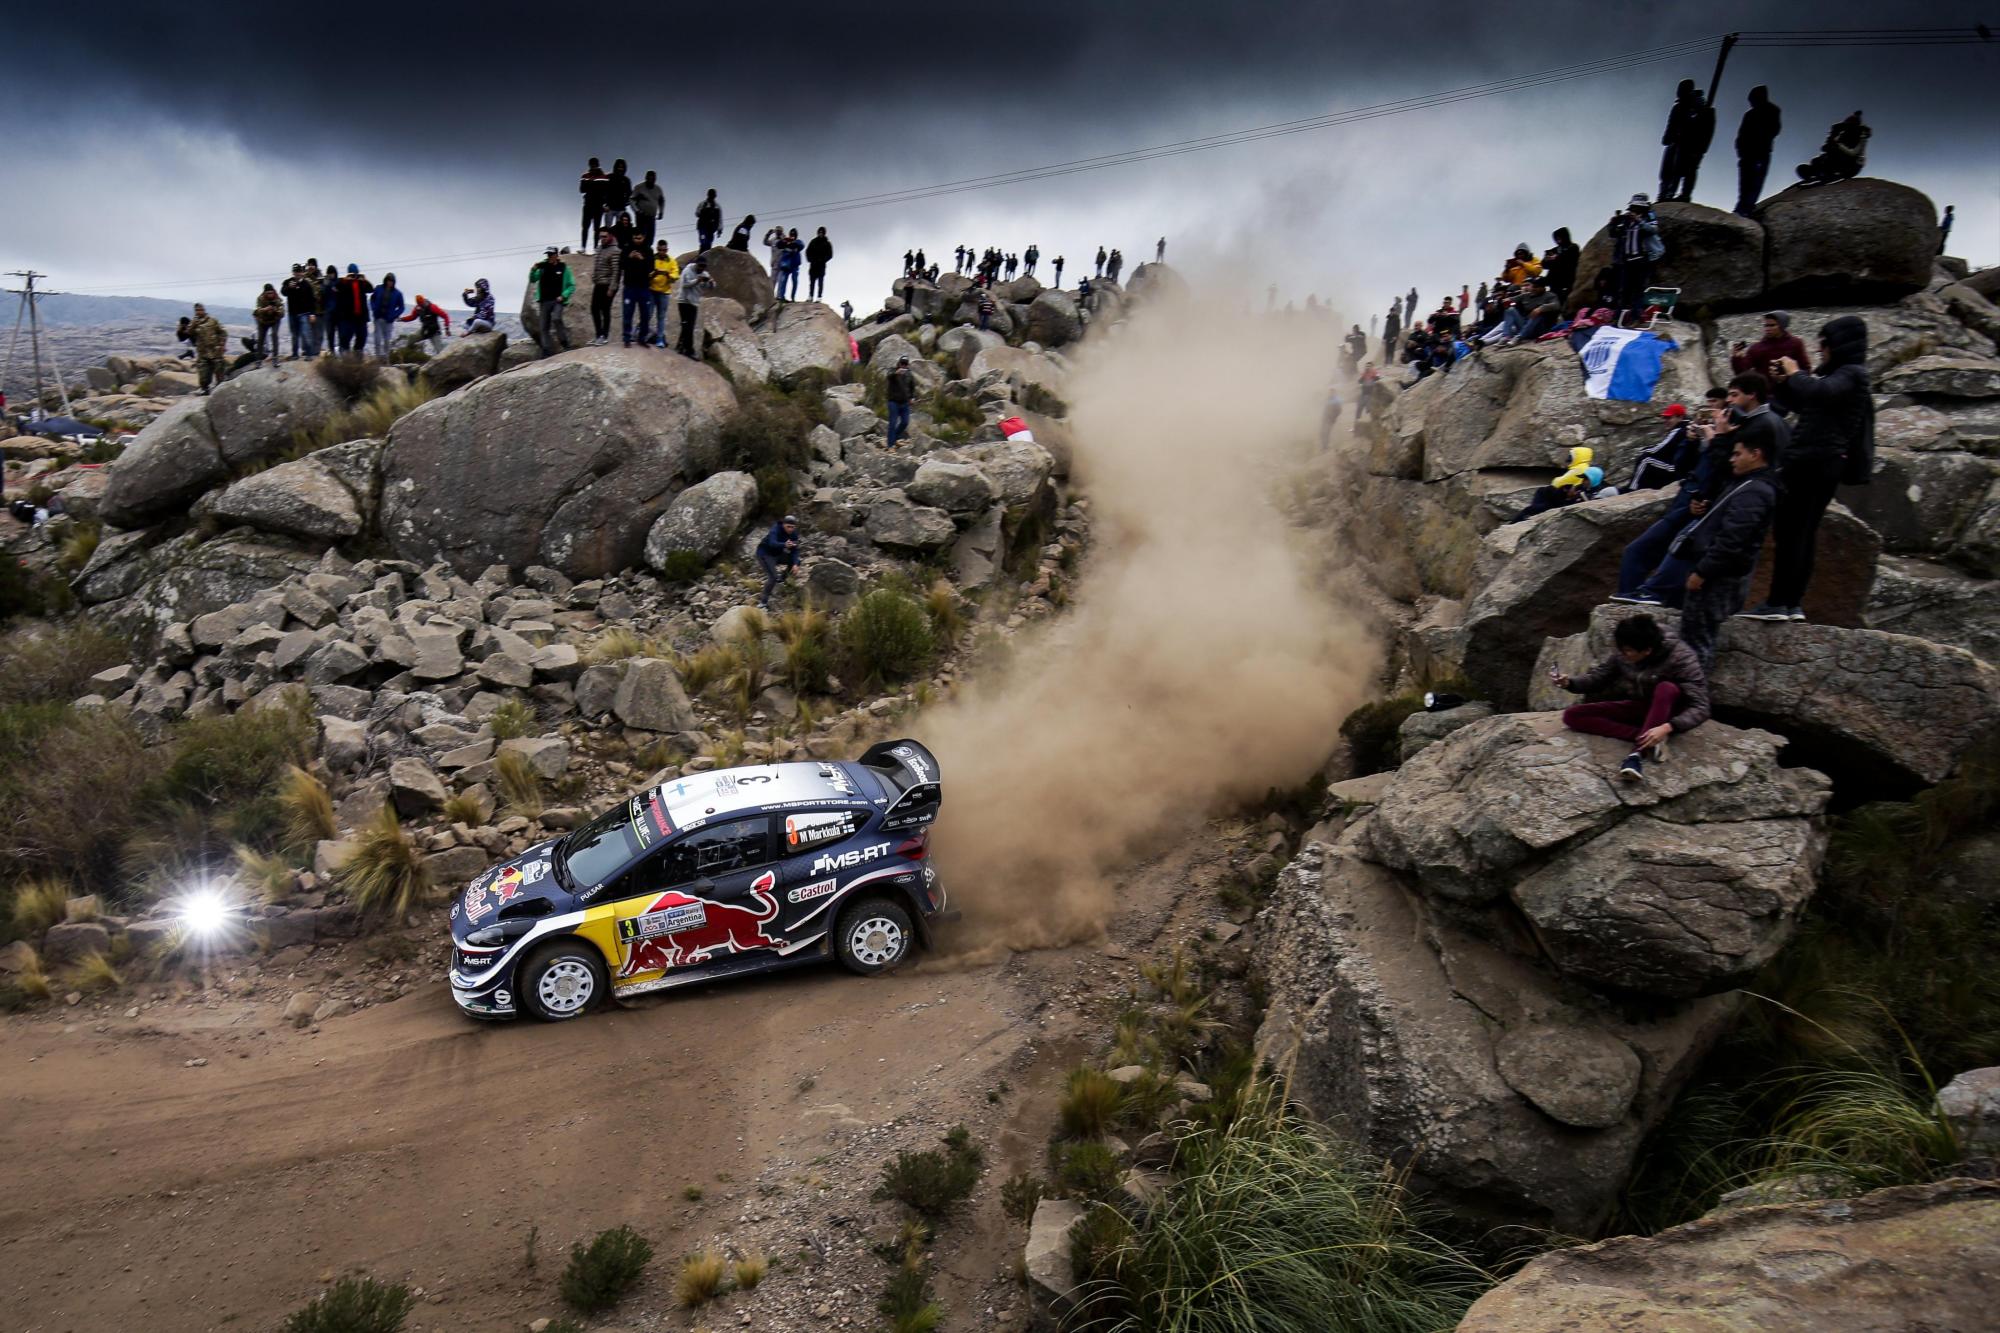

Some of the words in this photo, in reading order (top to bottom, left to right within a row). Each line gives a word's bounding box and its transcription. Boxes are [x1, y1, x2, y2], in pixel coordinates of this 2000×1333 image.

[737, 775, 771, 785] 3
[761, 799, 868, 810] www.MSPORTSTORE.com
[786, 819, 798, 845] 3
[800, 831, 808, 843] M
[808, 824, 841, 841] Markkula
[826, 841, 891, 872] MS-RT
[580, 883, 605, 902] PULSAR
[800, 880, 835, 899] Castrol
[624, 919, 635, 937] 3
[667, 912, 703, 927] Argentina
